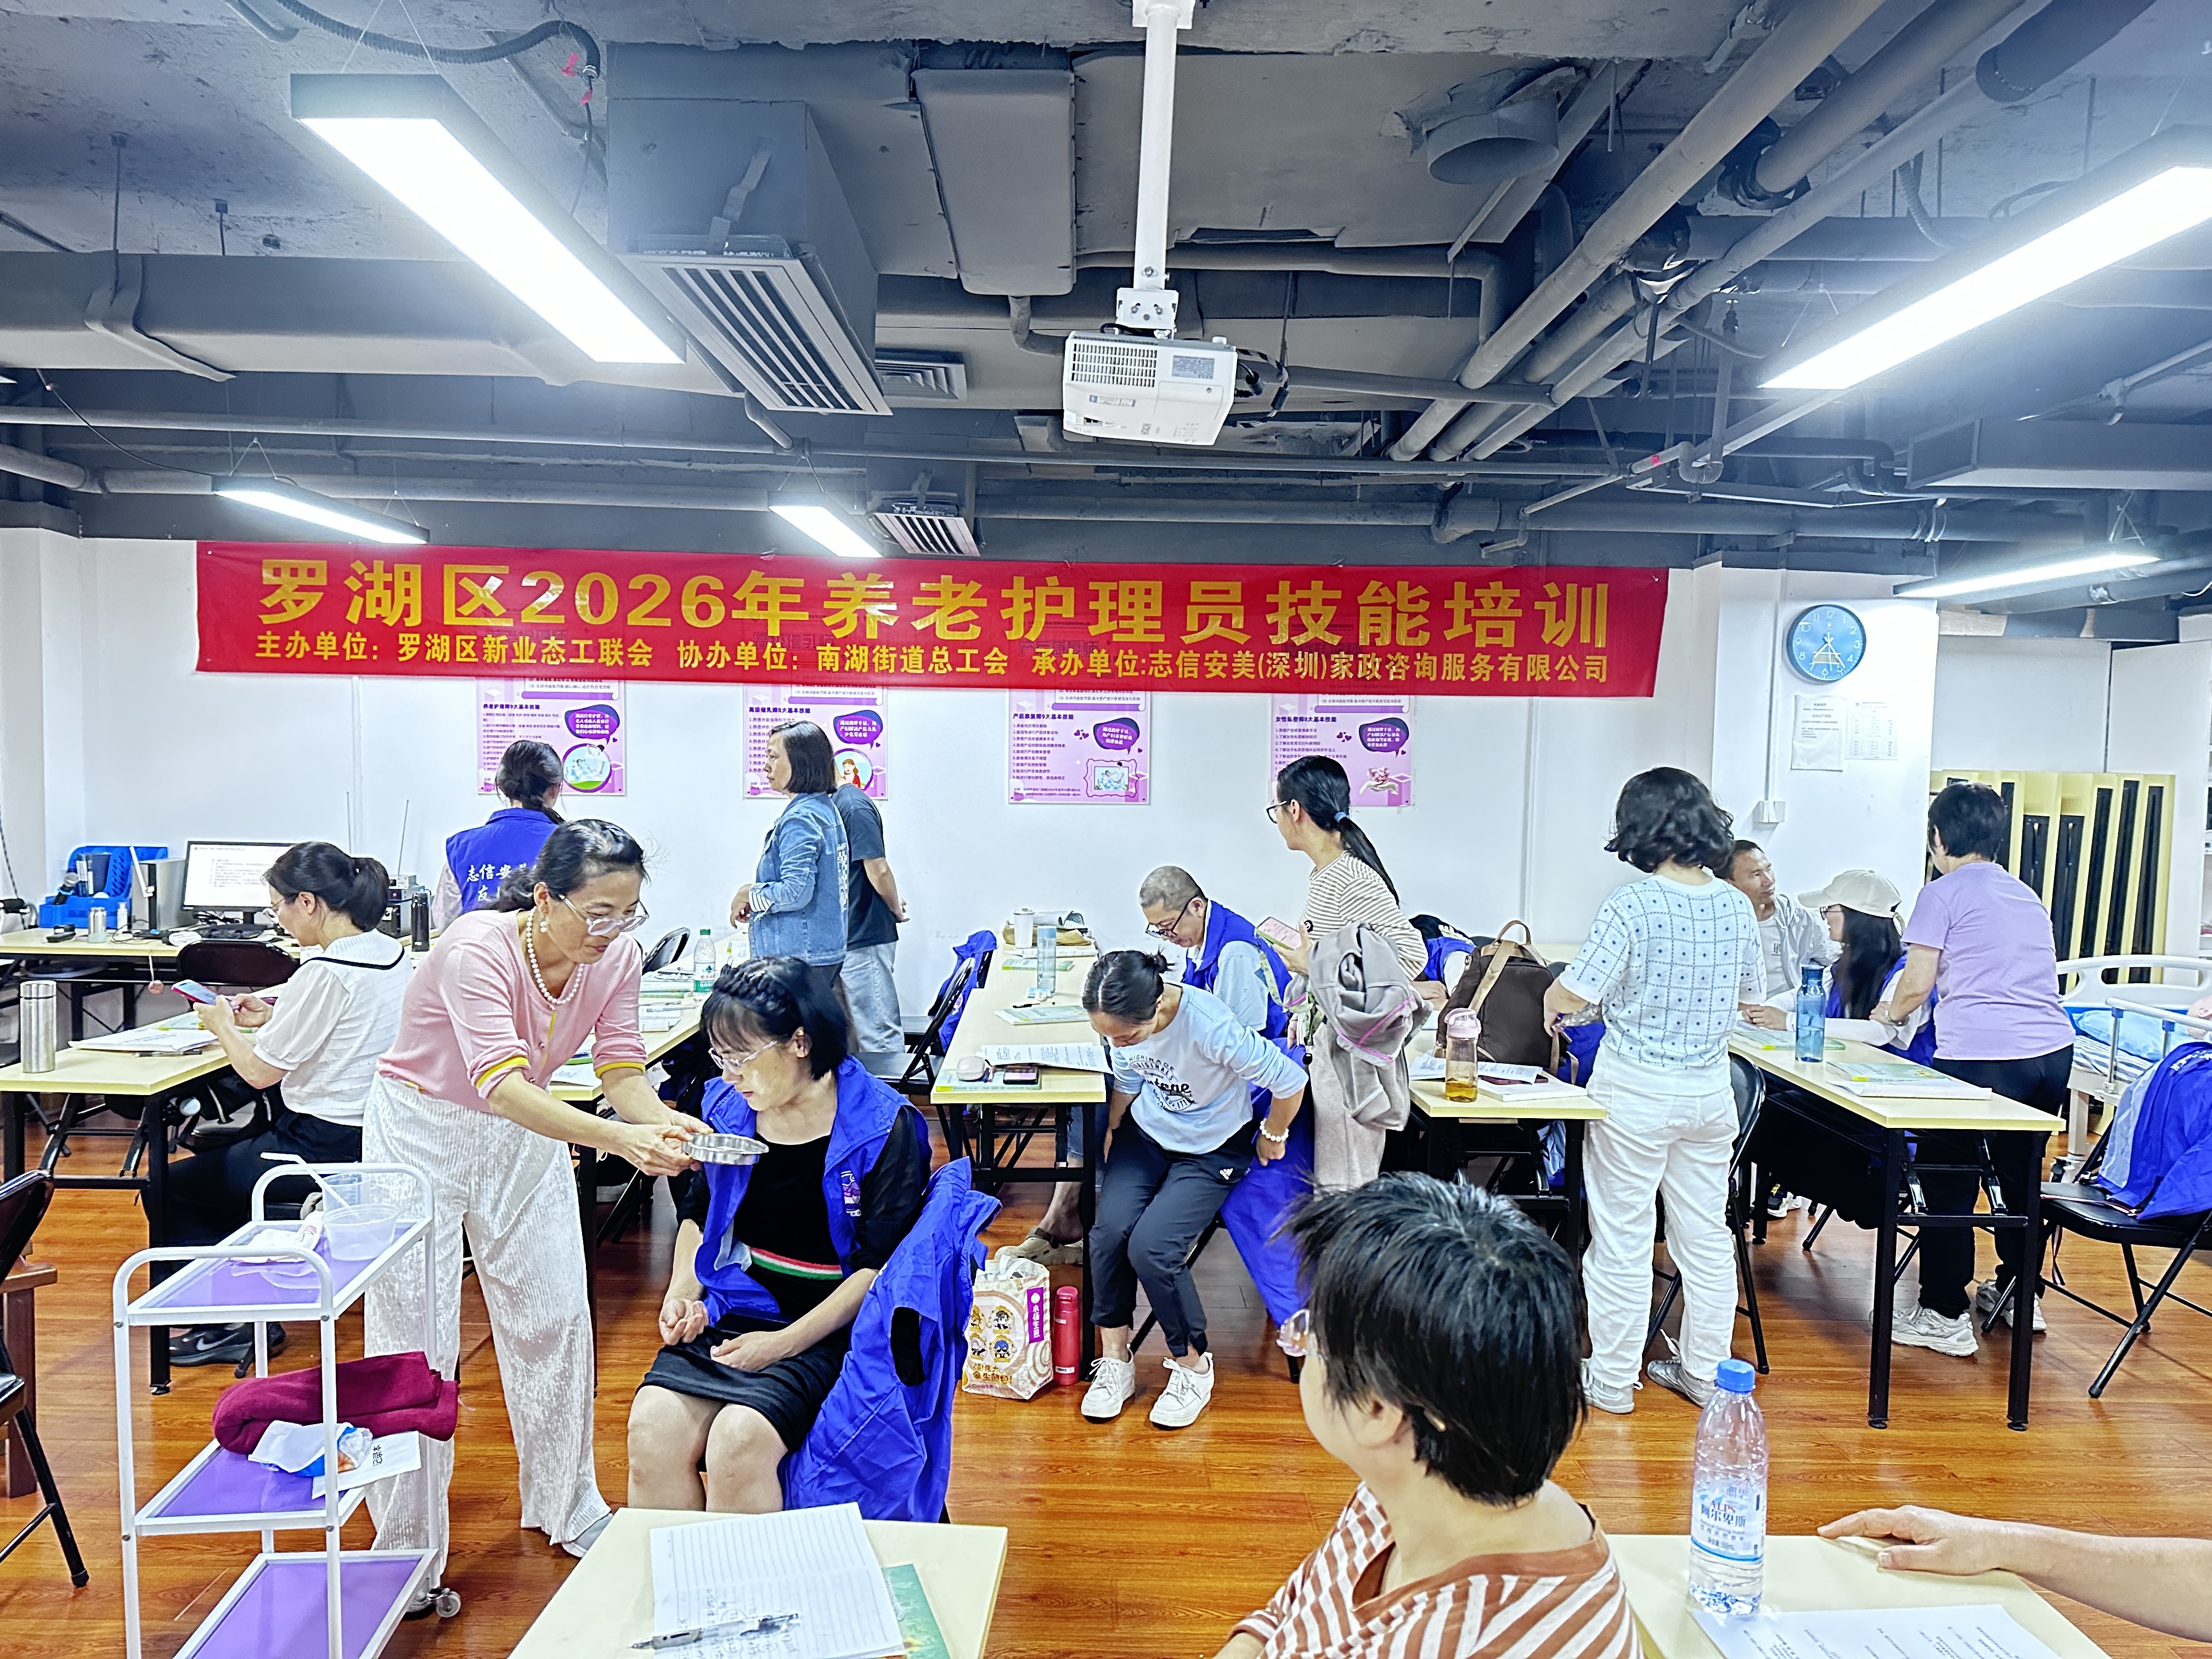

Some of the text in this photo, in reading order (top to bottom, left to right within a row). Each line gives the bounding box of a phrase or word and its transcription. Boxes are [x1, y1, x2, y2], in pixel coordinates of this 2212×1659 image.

[257, 559, 1609, 648] 罗湖区2026年养老护理员技能培训
[1813, 613, 1820, 622] 11
[1827, 610, 1835, 619] 12
[1850, 625, 1857, 635] 2
[1795, 637, 1802, 646] 9
[1853, 640, 1860, 648] 3
[1799, 651, 1805, 660] 8
[1847, 654, 1853, 662] 4
[1821, 668, 1829, 676] 6
[467, 863, 537, 882] 志信安
[1710, 1500, 1736, 1514] ALPS
[1701, 1504, 1746, 1527] 阿尔卑斯
